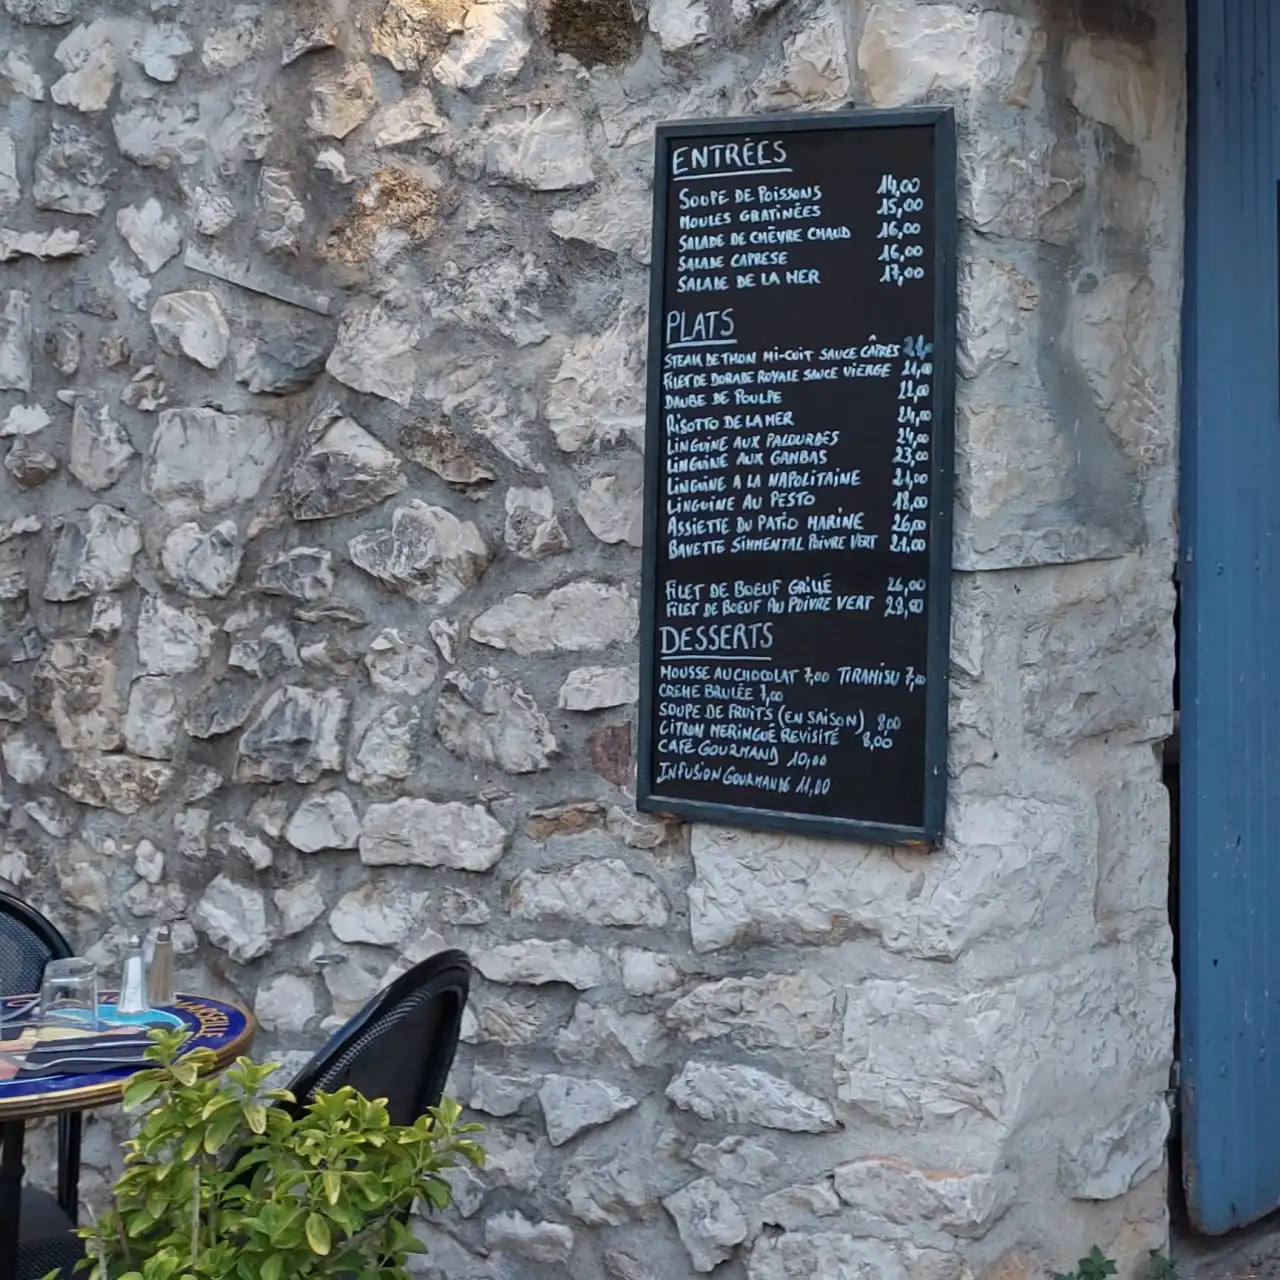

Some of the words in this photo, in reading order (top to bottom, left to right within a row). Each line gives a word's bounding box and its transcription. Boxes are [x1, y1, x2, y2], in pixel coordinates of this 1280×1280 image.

[679, 187, 730, 210] SOUPE
[734, 188, 755, 204] DE
[876, 174, 921, 198] 14,00
[679, 211, 732, 231] MOULES
[876, 198, 924, 219] 15,00
[678, 233, 726, 253] SALADE
[730, 231, 747, 247] DE
[807, 225, 852, 241] CHAUD
[876, 221, 922, 240] 16,00
[677, 255, 725, 272] SALADE
[730, 251, 789, 268] CAPRESE
[877, 244, 924, 263] 16,00
[676, 275, 730, 293] SALADE
[736, 273, 756, 289] DE
[761, 271, 781, 286] LA
[786, 269, 822, 285] MER
[880, 264, 925, 288] 17,00
[666, 308, 735, 343] PLATS
[663, 352, 704, 370] STEAK
[705, 351, 720, 367] DE
[720, 351, 757, 366] THON
[818, 347, 859, 360] SAUCE
[693, 372, 709, 388] DE
[711, 371, 756, 387] DORADE
[757, 368, 800, 384] ROYALE
[803, 366, 840, 380] SAUCE
[664, 393, 708, 410] DAUBE
[711, 390, 731, 406] DE
[733, 388, 784, 406] POULPE
[722, 414, 744, 430] DE
[744, 413, 764, 429] LA
[764, 411, 795, 427] MER
[732, 434, 761, 450] AUX
[735, 451, 765, 466] AUX
[892, 446, 929, 468] 23,00
[746, 473, 761, 489] LA
[742, 494, 763, 511] AU
[770, 490, 816, 508] PESTO
[892, 490, 929, 512] 18,00
[736, 516, 753, 535] DU
[757, 511, 799, 532] PATIO
[668, 539, 727, 560] BAVETTE
[850, 533, 879, 549] VERT
[665, 579, 706, 601] FILET
[709, 582, 730, 599] DE
[734, 580, 783, 598] BOEUF
[666, 601, 700, 618] FILET
[702, 602, 719, 618] DE
[722, 599, 763, 616] BOEUF
[767, 597, 785, 614] AU
[836, 595, 875, 611] VERT
[659, 622, 774, 655] DESSERTS
[660, 665, 711, 680] MOUSSE
[713, 666, 732, 680] AU
[803, 666, 830, 686] 7,00
[759, 683, 783, 707] 7,00
[658, 701, 702, 719] SOUPE
[705, 703, 724, 719] DE
[862, 730, 893, 752] 8,00
[697, 739, 780, 766] GOURMAND
[786, 750, 828, 771] 10,00
